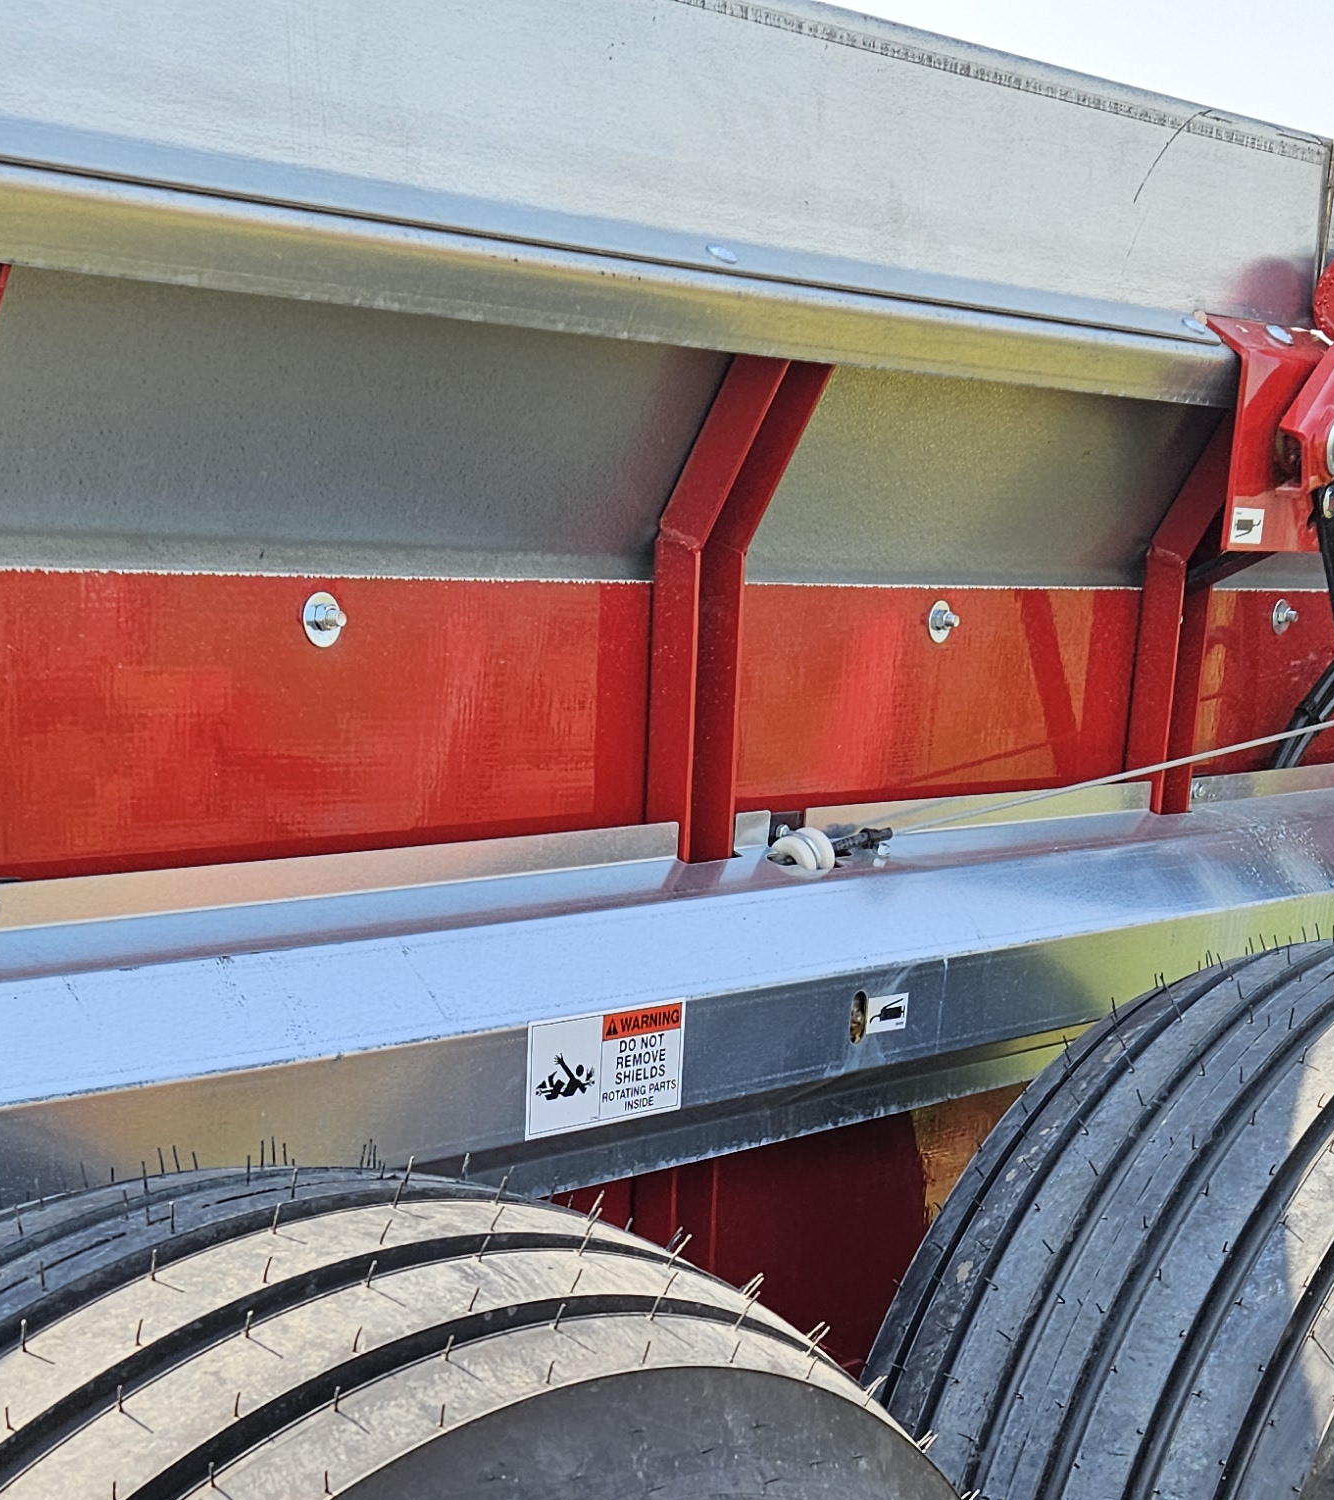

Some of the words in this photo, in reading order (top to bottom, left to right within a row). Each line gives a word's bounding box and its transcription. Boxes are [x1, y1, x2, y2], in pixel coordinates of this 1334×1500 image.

[620, 1008, 680, 1033] WARNING
[619, 1038, 636, 1053] DO
[640, 1033, 665, 1050] NOT
[616, 1048, 666, 1070] REMOVE
[615, 1064, 666, 1085] SHIELDS
[602, 1085, 647, 1103] ROTATING
[648, 1079, 677, 1094] PARTS
[624, 1096, 654, 1111] INSIDE
